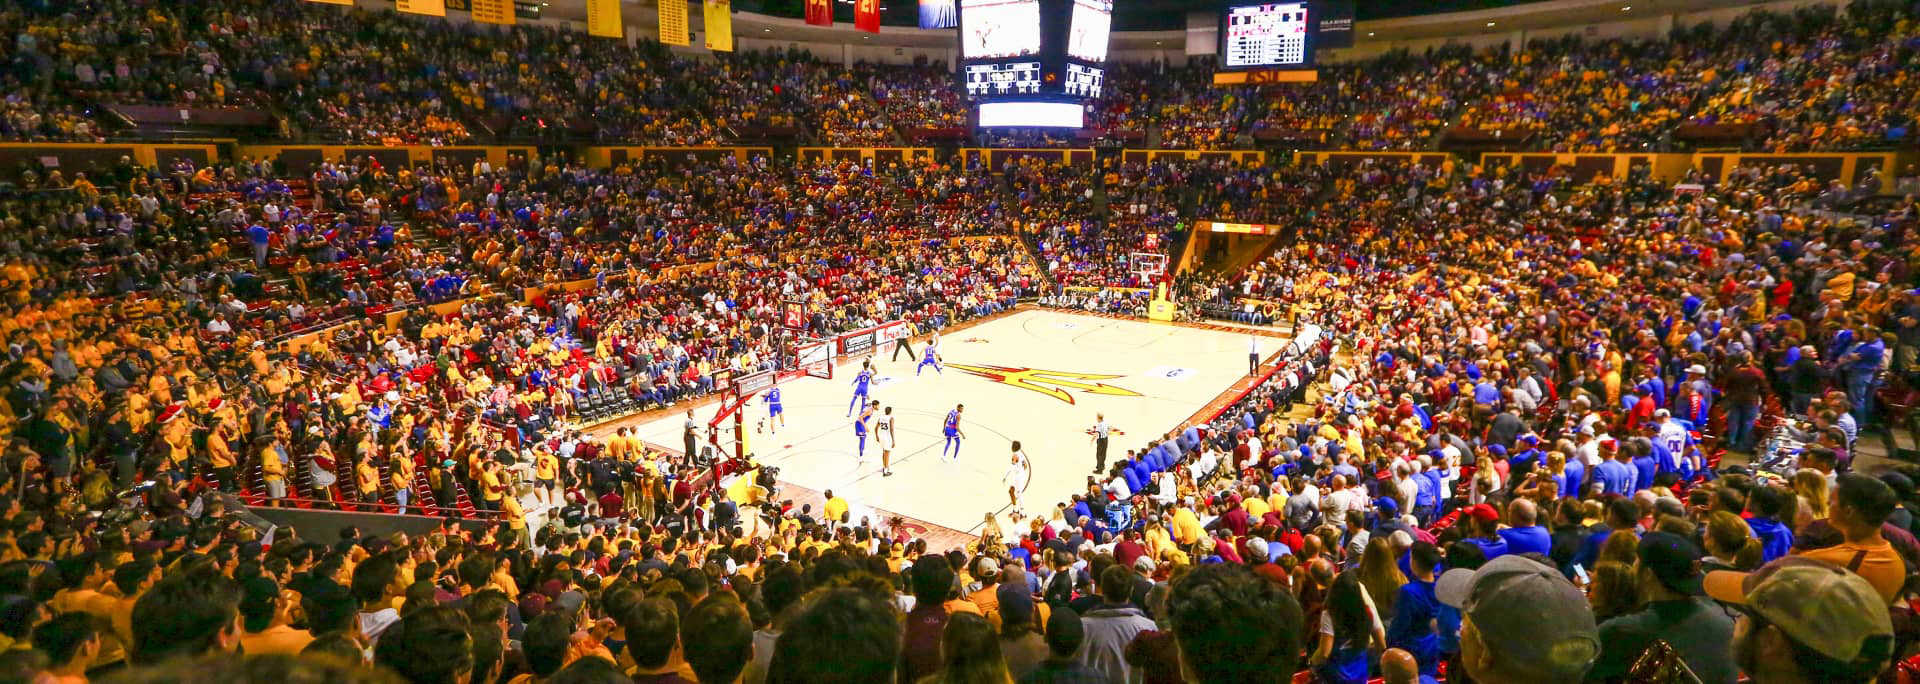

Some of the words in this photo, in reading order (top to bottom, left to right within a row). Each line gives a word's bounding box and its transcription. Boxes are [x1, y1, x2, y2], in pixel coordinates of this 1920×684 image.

[1245, 70, 1279, 83] ASU
[787, 311, 801, 326] 24
[861, 374, 867, 383] 0
[772, 390, 778, 399] 5
[880, 422, 889, 431] 23
[1668, 439, 1681, 453] 00
